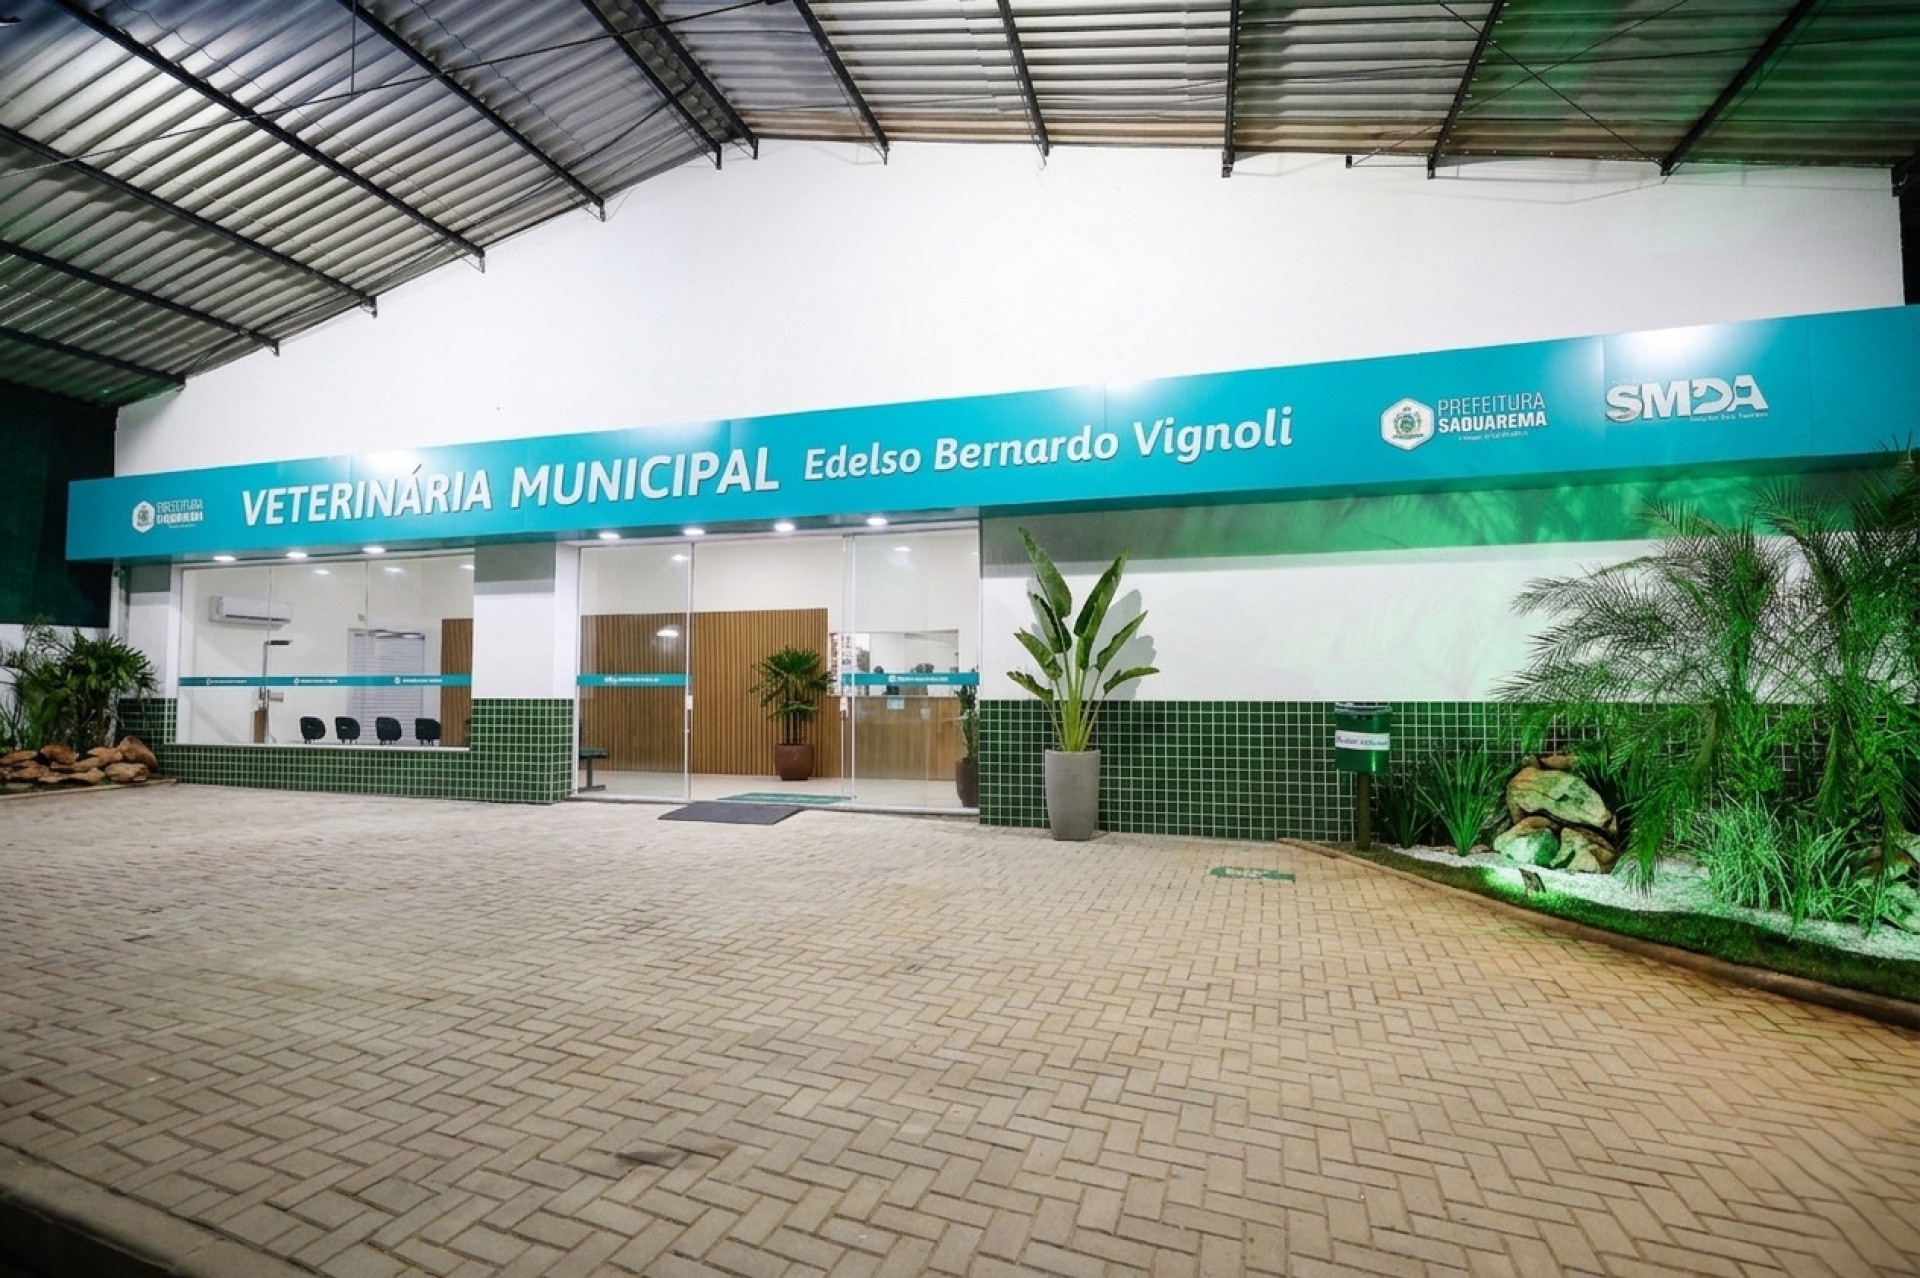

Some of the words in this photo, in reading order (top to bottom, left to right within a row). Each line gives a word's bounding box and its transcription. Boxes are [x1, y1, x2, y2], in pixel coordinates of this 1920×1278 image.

[1437, 392, 1546, 417] PREFEITURA
[1606, 374, 1768, 422] SMDA
[242, 464, 493, 526] VETERINÁRIA
[510, 447, 780, 508] MUNICIPAL
[804, 443, 921, 481] Edelso
[933, 425, 1119, 471] Bernardo
[1133, 406, 1293, 464] Vignoli
